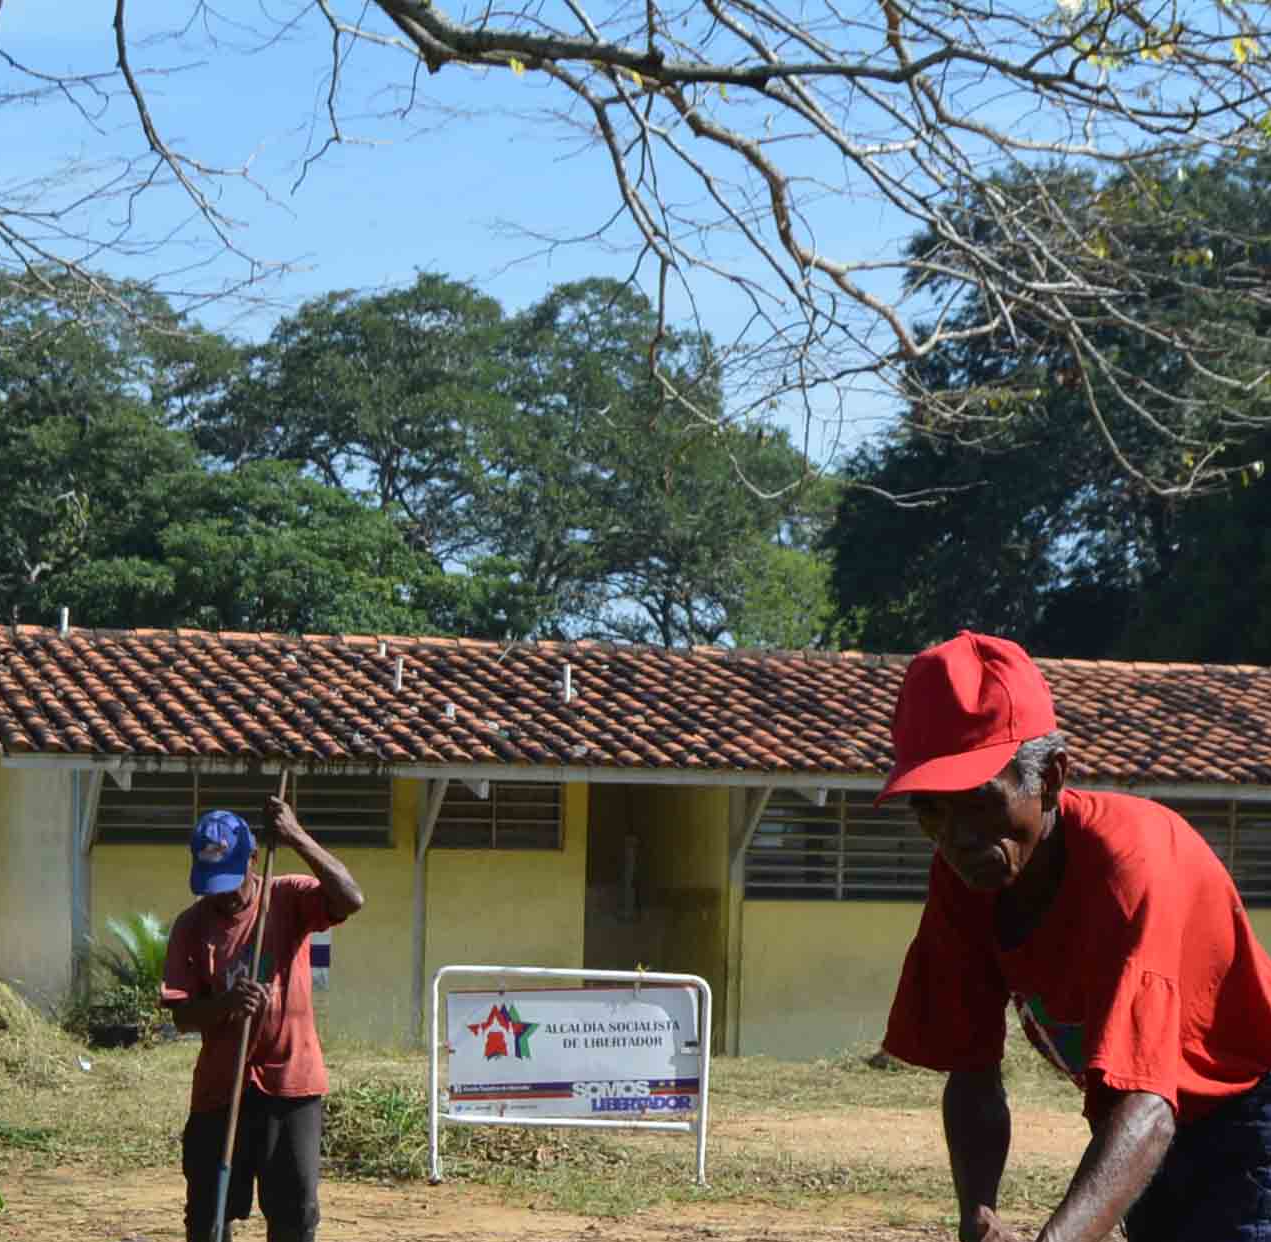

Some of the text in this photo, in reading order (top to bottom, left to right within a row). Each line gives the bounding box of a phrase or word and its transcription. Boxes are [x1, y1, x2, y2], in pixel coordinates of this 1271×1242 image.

[609, 1019, 681, 1033] SOCIALISTA
[563, 1036, 663, 1049] DE LIBERTADOR
[572, 1080, 651, 1098] SOMOS
[592, 1096, 692, 1112] LIBERTADOR
